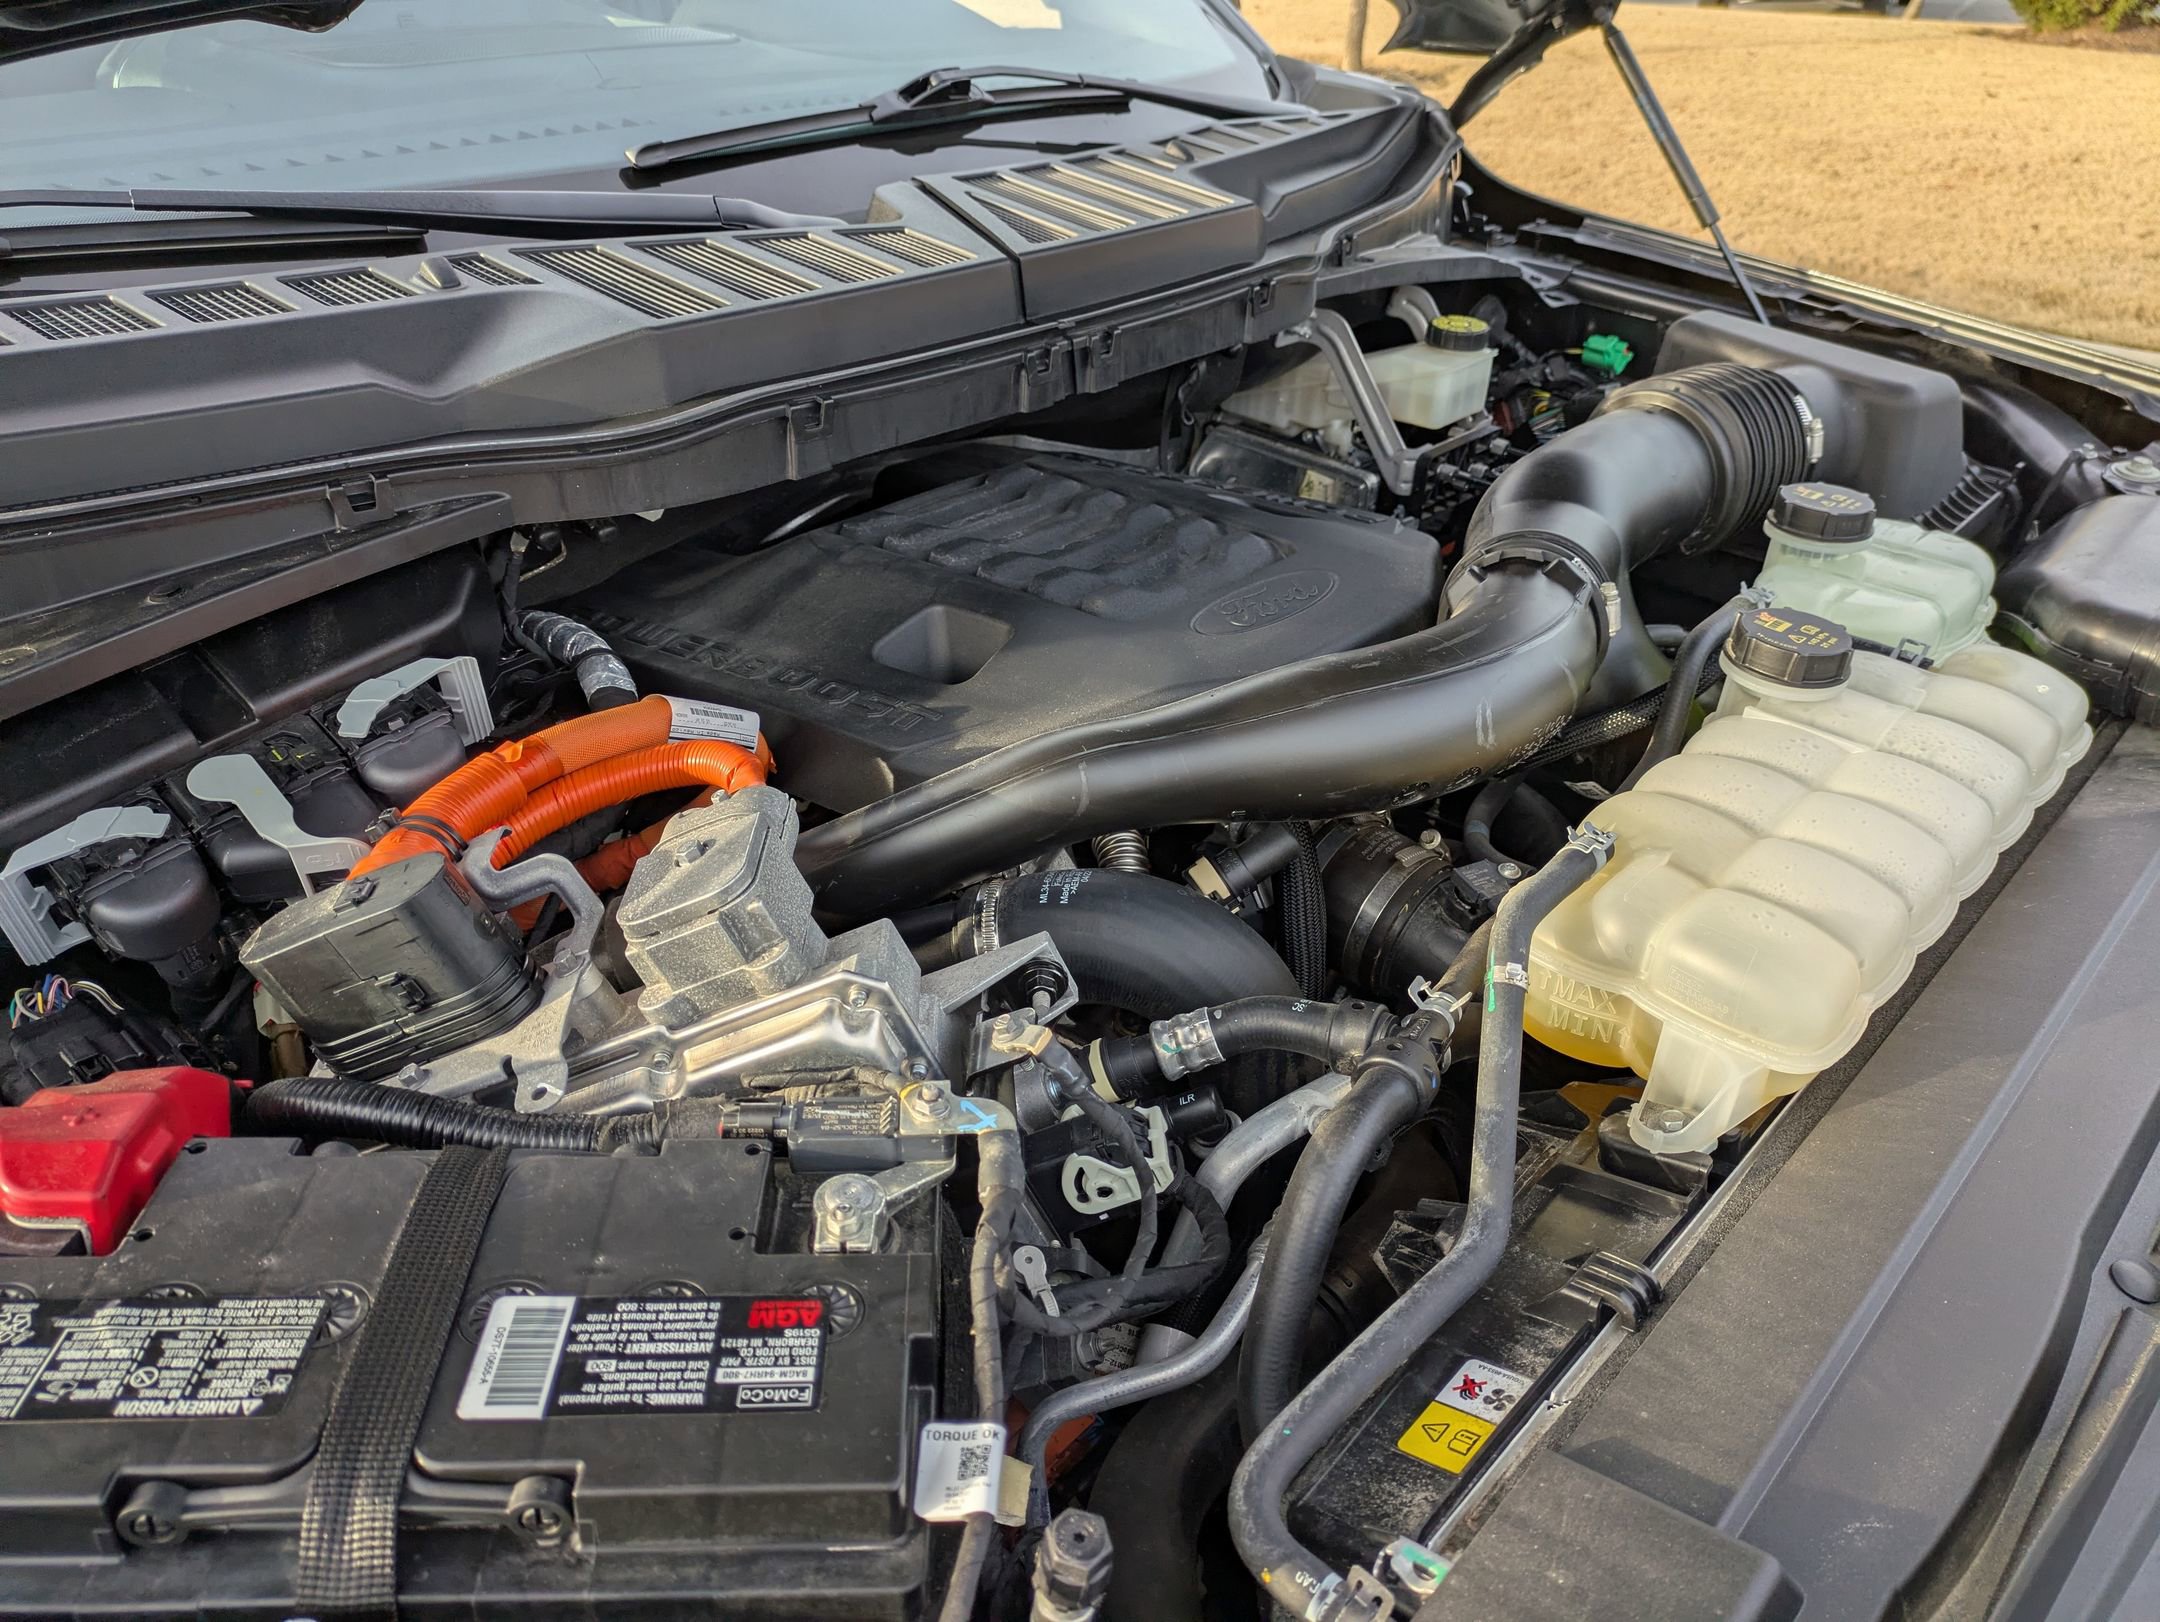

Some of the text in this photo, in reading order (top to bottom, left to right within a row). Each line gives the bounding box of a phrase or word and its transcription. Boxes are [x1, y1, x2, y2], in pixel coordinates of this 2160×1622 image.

[1217, 583, 1320, 628] Ford
[574, 613, 943, 731] OWERBOOST
[1060, 883, 1070, 904] Made
[1552, 973, 1619, 1015] MAX
[1547, 1004, 1615, 1043] MIN
[1179, 1093, 1196, 1106] ILR
[256, 1299, 268, 1307] LA
[297, 1299, 313, 1307] PAS
[312, 1299, 325, 1307] NE
[616, 1302, 638, 1311] 800
[645, 1302, 677, 1311] volants
[708, 1302, 721, 1311] de
[253, 1308, 264, 1316] LA
[263, 1308, 276, 1316] DE
[275, 1308, 298, 1316] HORS
[298, 1308, 320, 1316] TENIR
[707, 1312, 719, 1321] de
[126, 1317, 140, 1325] DO
[153, 1317, 171, 1325] NOT
[170, 1317, 183, 1325] DO
[220, 1317, 232, 1325] OF
[232, 1317, 257, 1325] REACH
[256, 1317, 271, 1325] THE
[271, 1317, 282, 1325] OF
[281, 1317, 298, 1325] OUT
[297, 1317, 318, 1325] KEEP
[621, 1313, 656, 1321] secours
[747, 1309, 820, 1328] AGM
[611, 1323, 620, 1332] la
[576, 1333, 590, 1342] du
[591, 1332, 617, 1342] guide
[618, 1333, 627, 1342] le
[629, 1333, 648, 1342] Voir
[698, 1332, 715, 1341] des
[720, 1337, 819, 1348] DEARBORN, MI 48121
[593, 1343, 616, 1352] Pour
[624, 1342, 713, 1353] AVERTISSEMENT
[736, 1346, 818, 1357] FORD MOTOR CO.
[247, 1349, 263, 1358] LES
[590, 1360, 710, 1370] Cold cranking amps 800
[720, 1357, 742, 1366] PAR
[777, 1356, 790, 1365] BY
[241, 1369, 269, 1378] GASES
[600, 1370, 708, 1382] jump start instructions.
[207, 1378, 256, 1388] EXPLOSIVE
[580, 1381, 706, 1393] injury see owner guide for
[558, 1392, 704, 1405] WARNING: To avoid personal
[741, 1388, 810, 1403] FoMoCo
[113, 1400, 240, 1415] DANGER/POISON
[926, 1429, 1000, 1441] TORQUE OK
